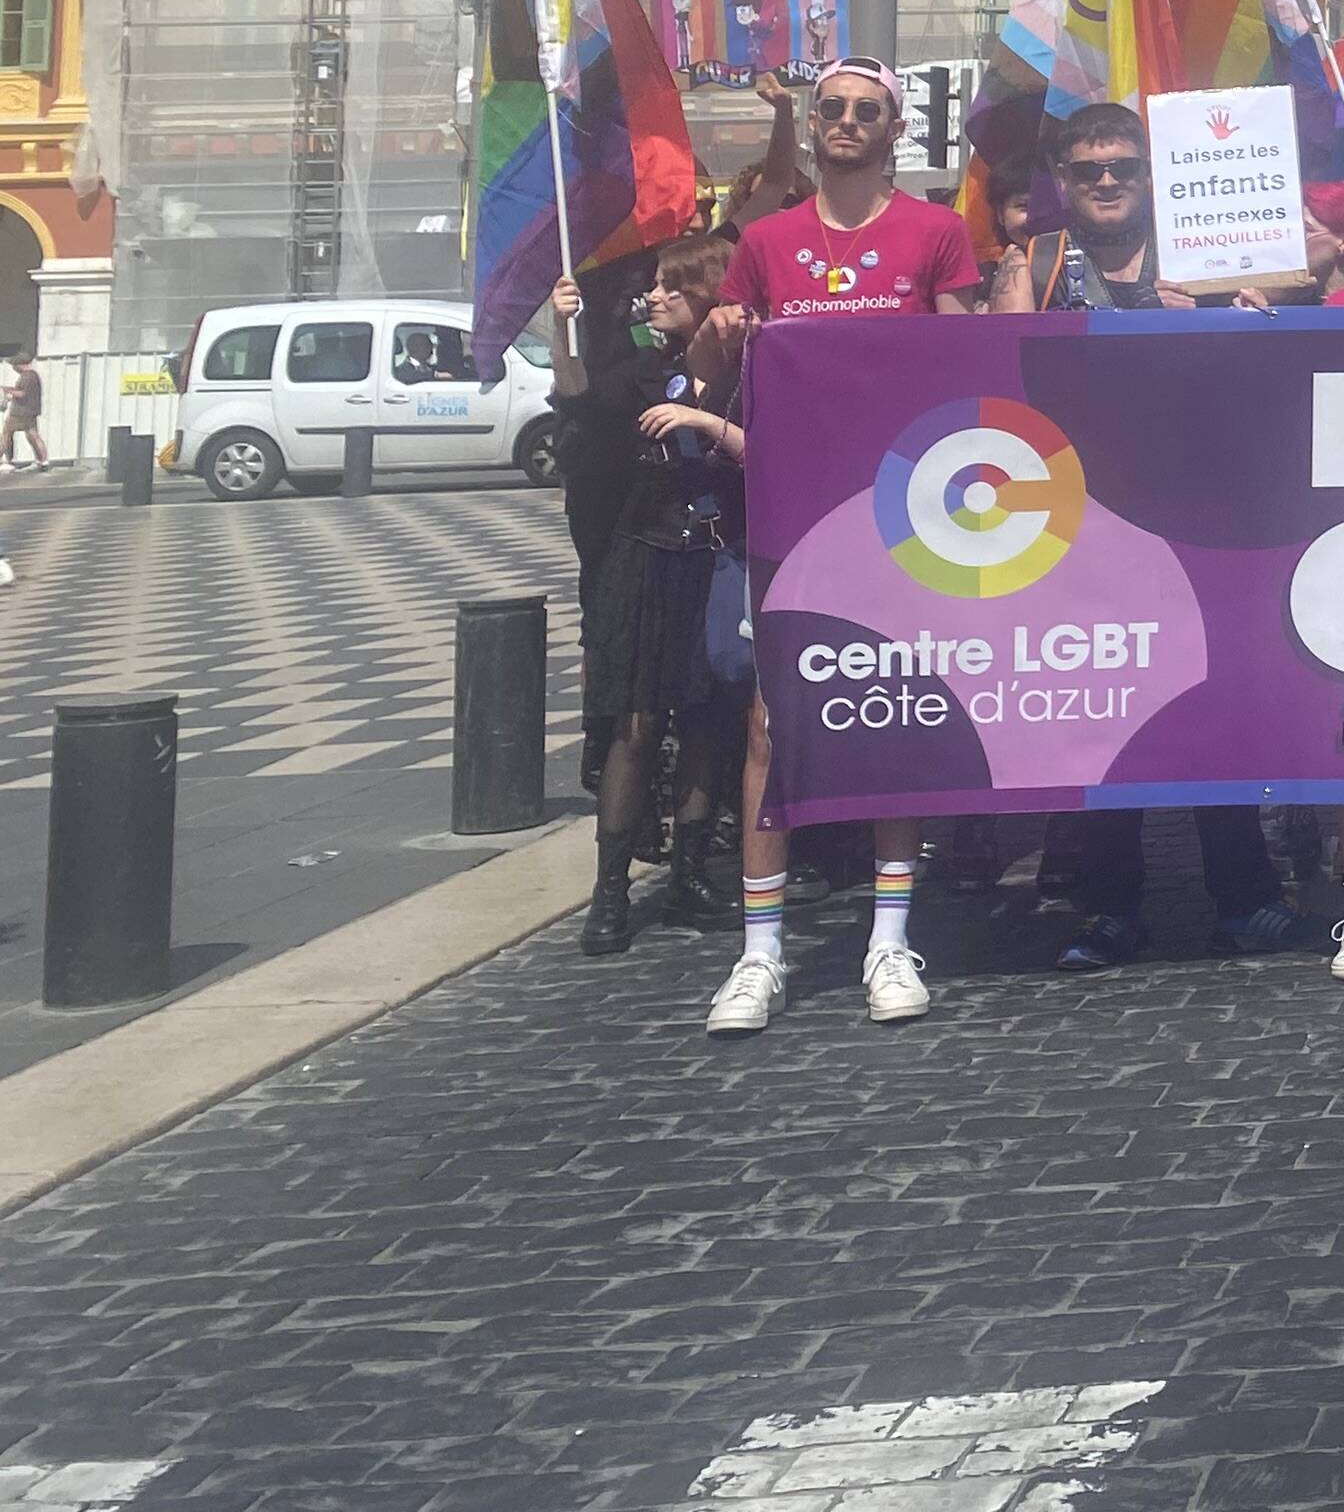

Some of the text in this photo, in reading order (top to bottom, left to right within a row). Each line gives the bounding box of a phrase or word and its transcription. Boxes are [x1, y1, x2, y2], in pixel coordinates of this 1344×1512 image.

[788, 61, 822, 81] KIDS
[1170, 144, 1280, 165] Laissez les
[1169, 172, 1286, 199] enfants
[1173, 206, 1287, 229] intersexes
[1172, 228, 1283, 250] TRANQUILLES
[798, 622, 1159, 682] centre LGBT
[821, 679, 1136, 731] côte d'azur
